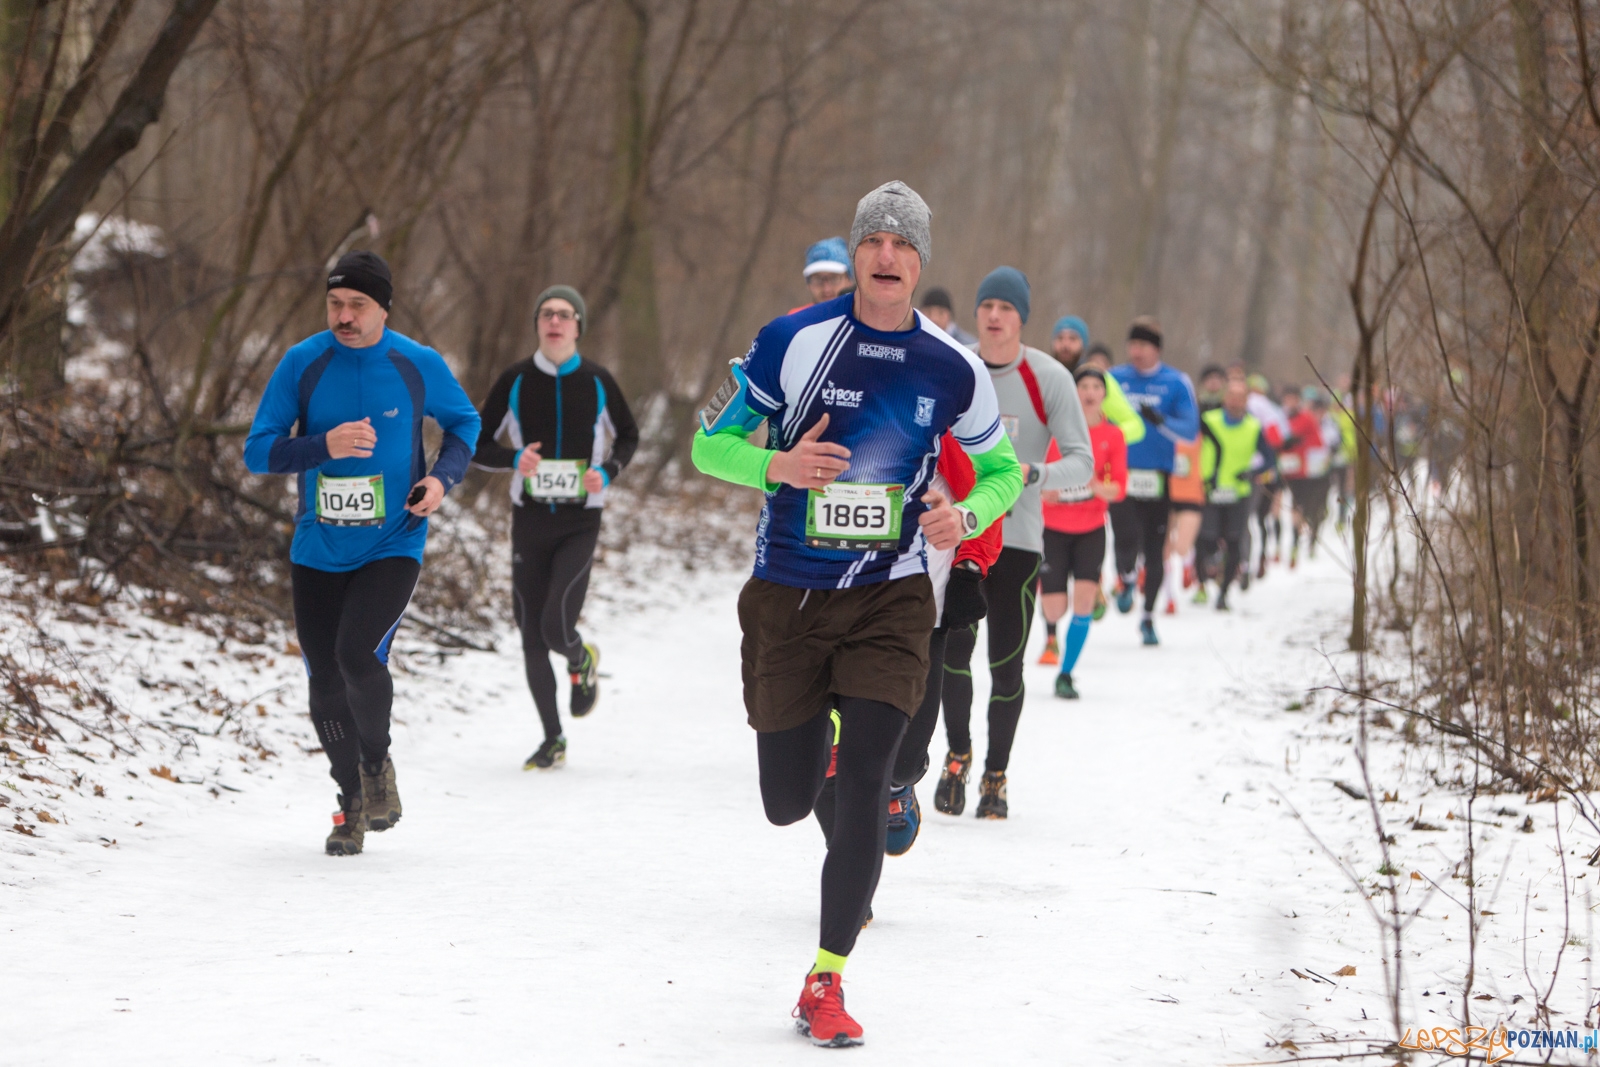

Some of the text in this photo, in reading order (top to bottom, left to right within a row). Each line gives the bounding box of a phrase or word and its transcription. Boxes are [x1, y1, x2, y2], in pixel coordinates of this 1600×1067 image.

[859, 343, 905, 356] EXTREME
[536, 472, 578, 489] 1547
[321, 491, 375, 511] 1049
[822, 503, 886, 529] 1863
